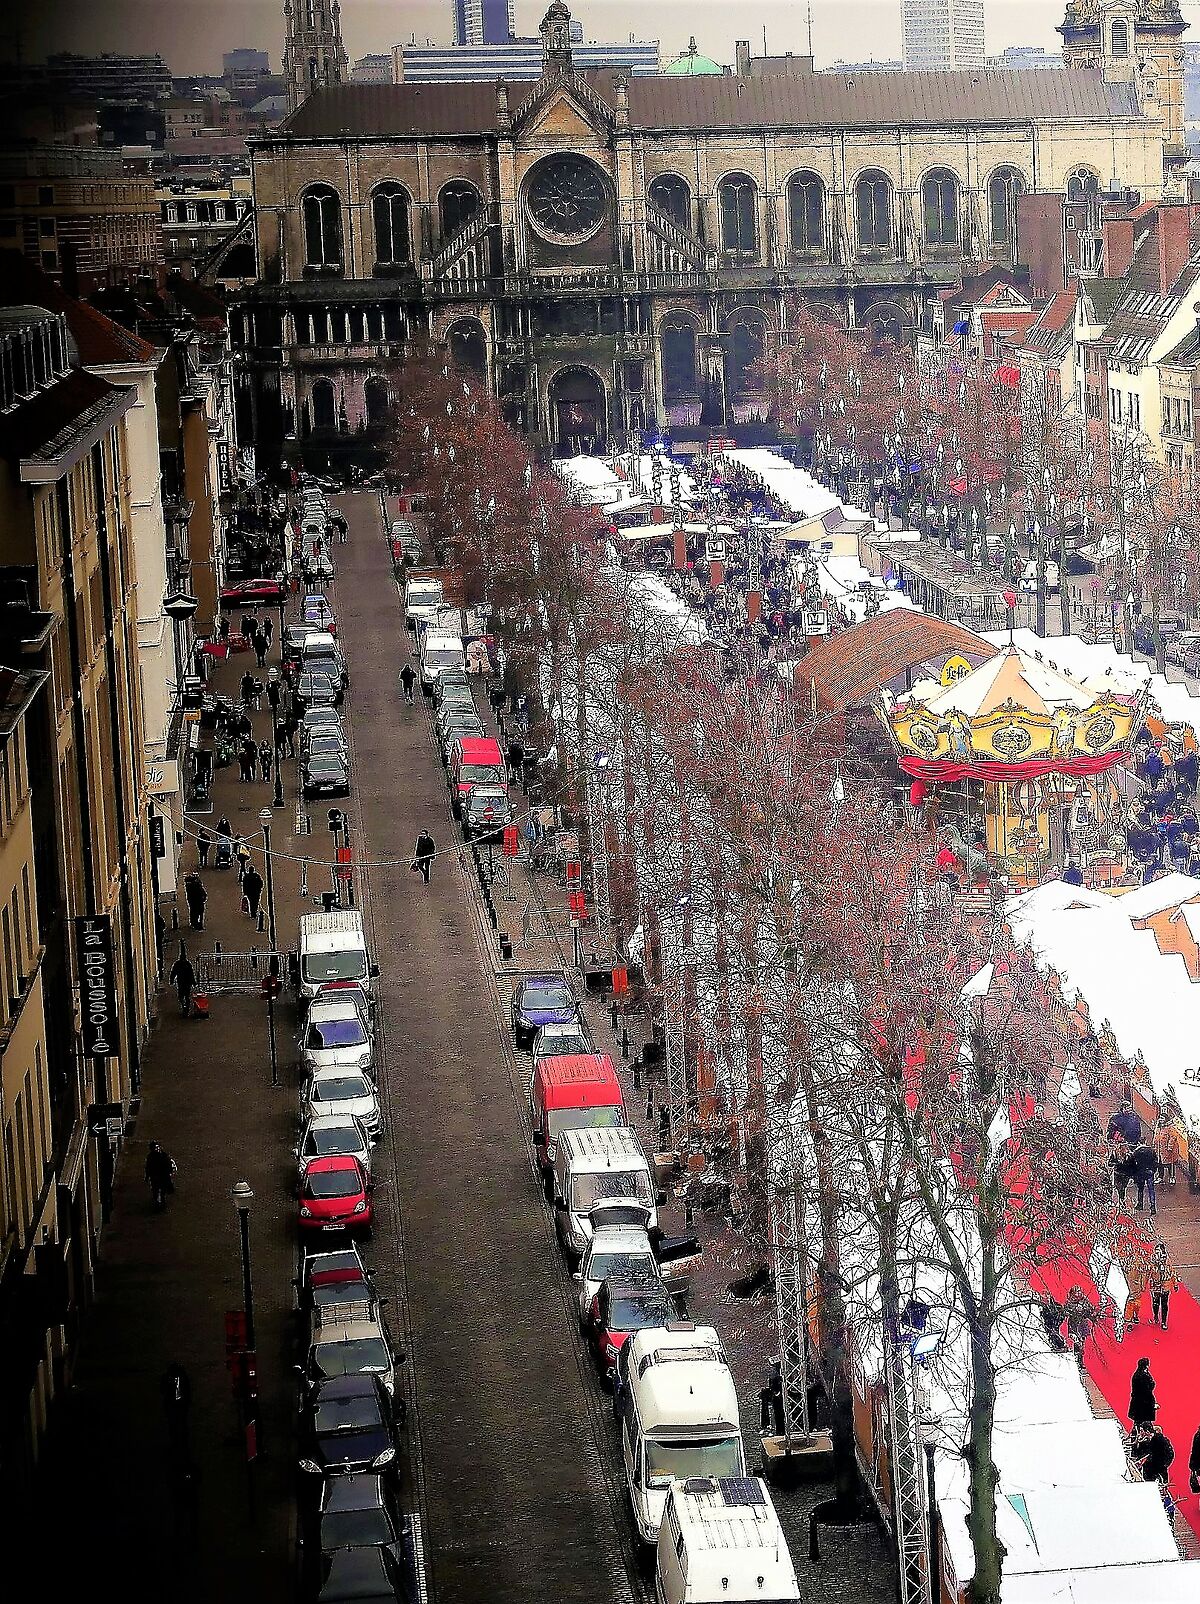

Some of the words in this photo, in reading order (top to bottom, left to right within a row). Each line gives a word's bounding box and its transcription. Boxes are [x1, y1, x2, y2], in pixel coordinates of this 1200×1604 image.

[220, 445, 229, 488] HOTEL
[83, 920, 104, 946] La
[83, 951, 110, 1053] Boussole
